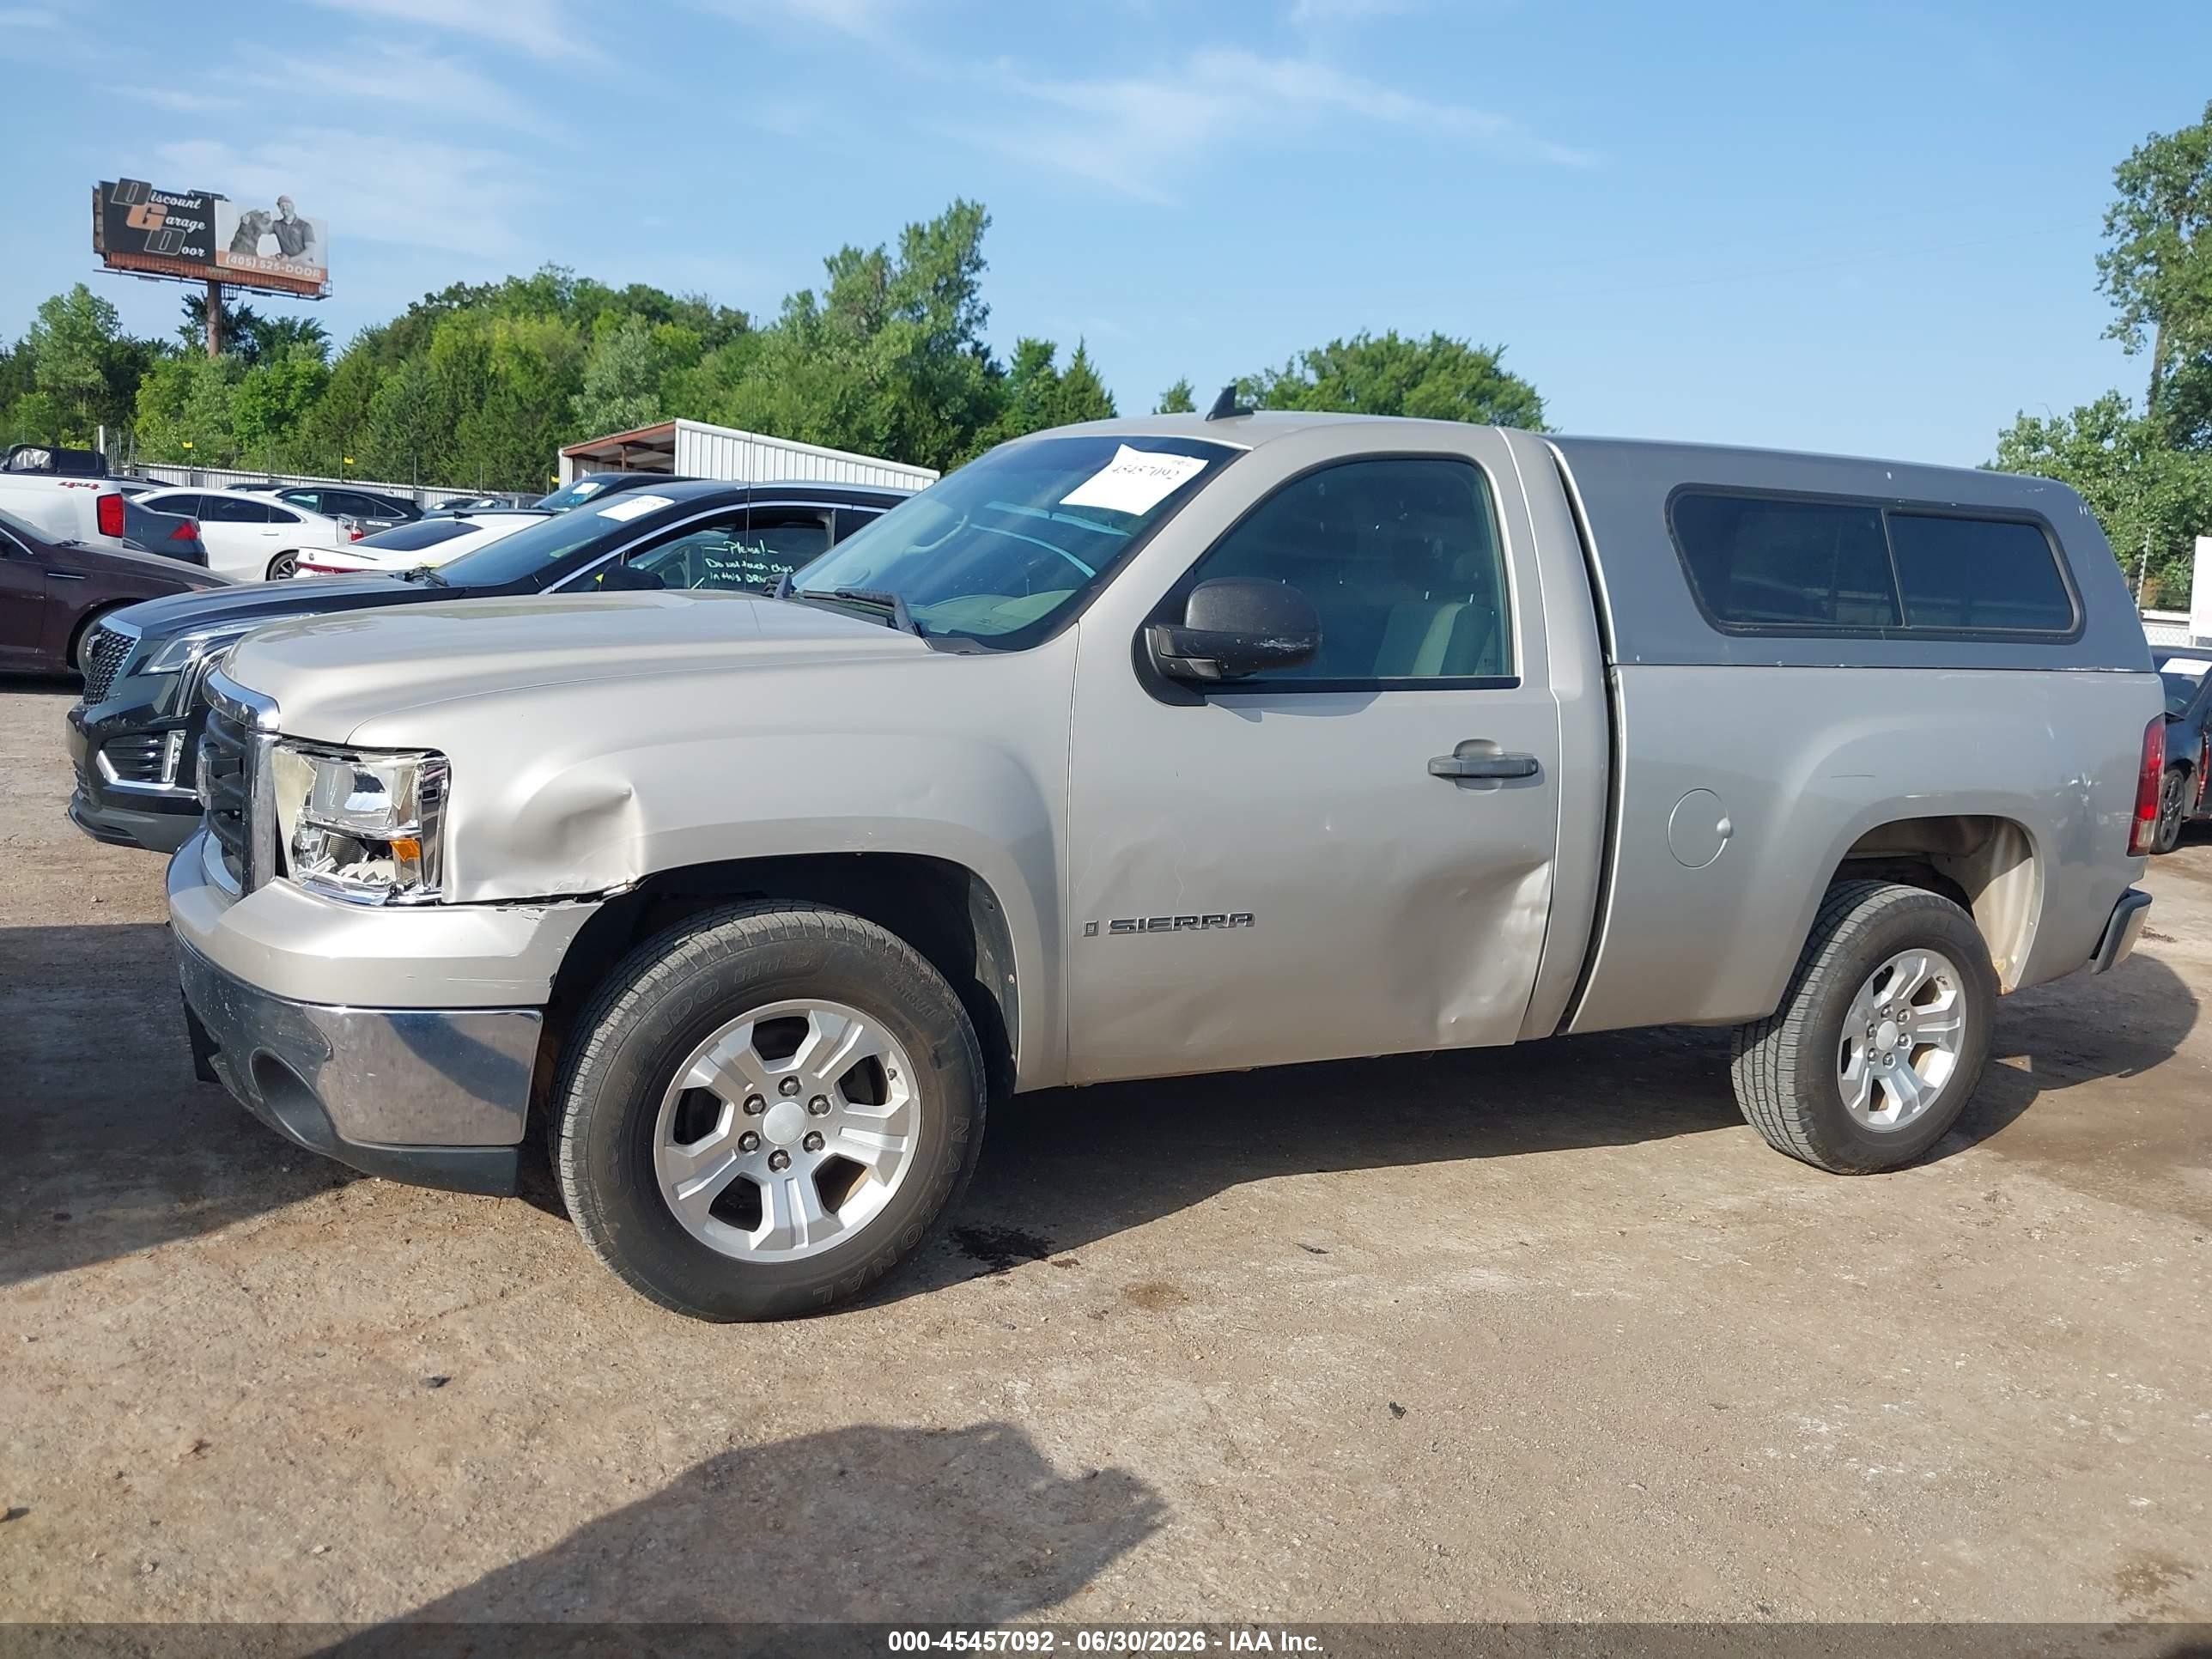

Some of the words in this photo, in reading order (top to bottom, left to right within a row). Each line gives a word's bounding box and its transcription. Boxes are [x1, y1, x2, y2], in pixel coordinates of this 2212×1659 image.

[111, 178, 202, 210] Discount
[126, 203, 206, 233] Garage
[144, 227, 205, 258] Door
[226, 254, 257, 269] (405)
[1108, 912, 1257, 935] SIERRA
